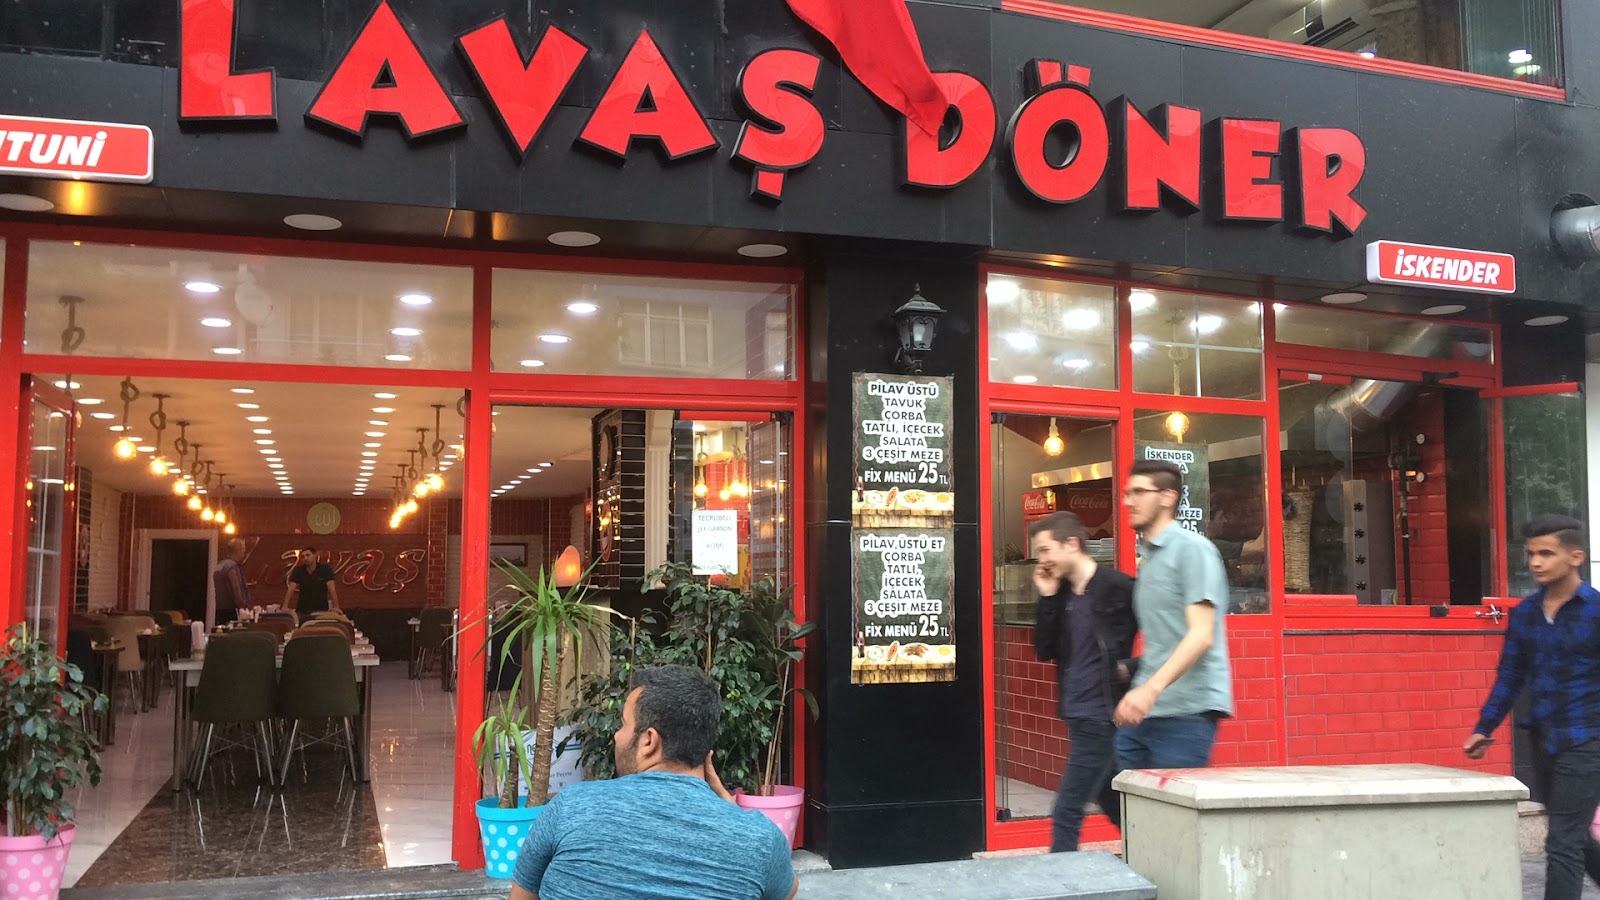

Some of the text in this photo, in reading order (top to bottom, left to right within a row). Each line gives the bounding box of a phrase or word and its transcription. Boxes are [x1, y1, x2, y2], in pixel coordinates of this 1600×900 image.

[179, 0, 1368, 236] LAVAŞ DÖNER
[1394, 248, 1500, 285] İSKENDER
[870, 382, 937, 396] PİLAV ÜSTÜ
[885, 398, 923, 408] TAVUK
[884, 411, 923, 422] ÇORBA
[865, 422, 941, 436] TATLI, İÇECEK
[883, 437, 924, 446] SALATA
[865, 448, 941, 462] 3 ÇEŞİT MEZE
[1147, 448, 1192, 461] İSKENDER
[864, 462, 948, 485] FİX MENÜ 25 TL
[1176, 509, 1201, 518] MEZE
[898, 537, 927, 549] ÜSTÜ
[931, 540, 943, 549] ET
[884, 552, 922, 563] ÇORBA
[887, 564, 919, 575] TATLI,
[884, 576, 922, 588] İÇECEK
[883, 590, 924, 599] SALATA
[867, 602, 940, 615] 3 ÇEŞİT MEZE
[865, 615, 949, 638] FİX MENÜ 25 TL
